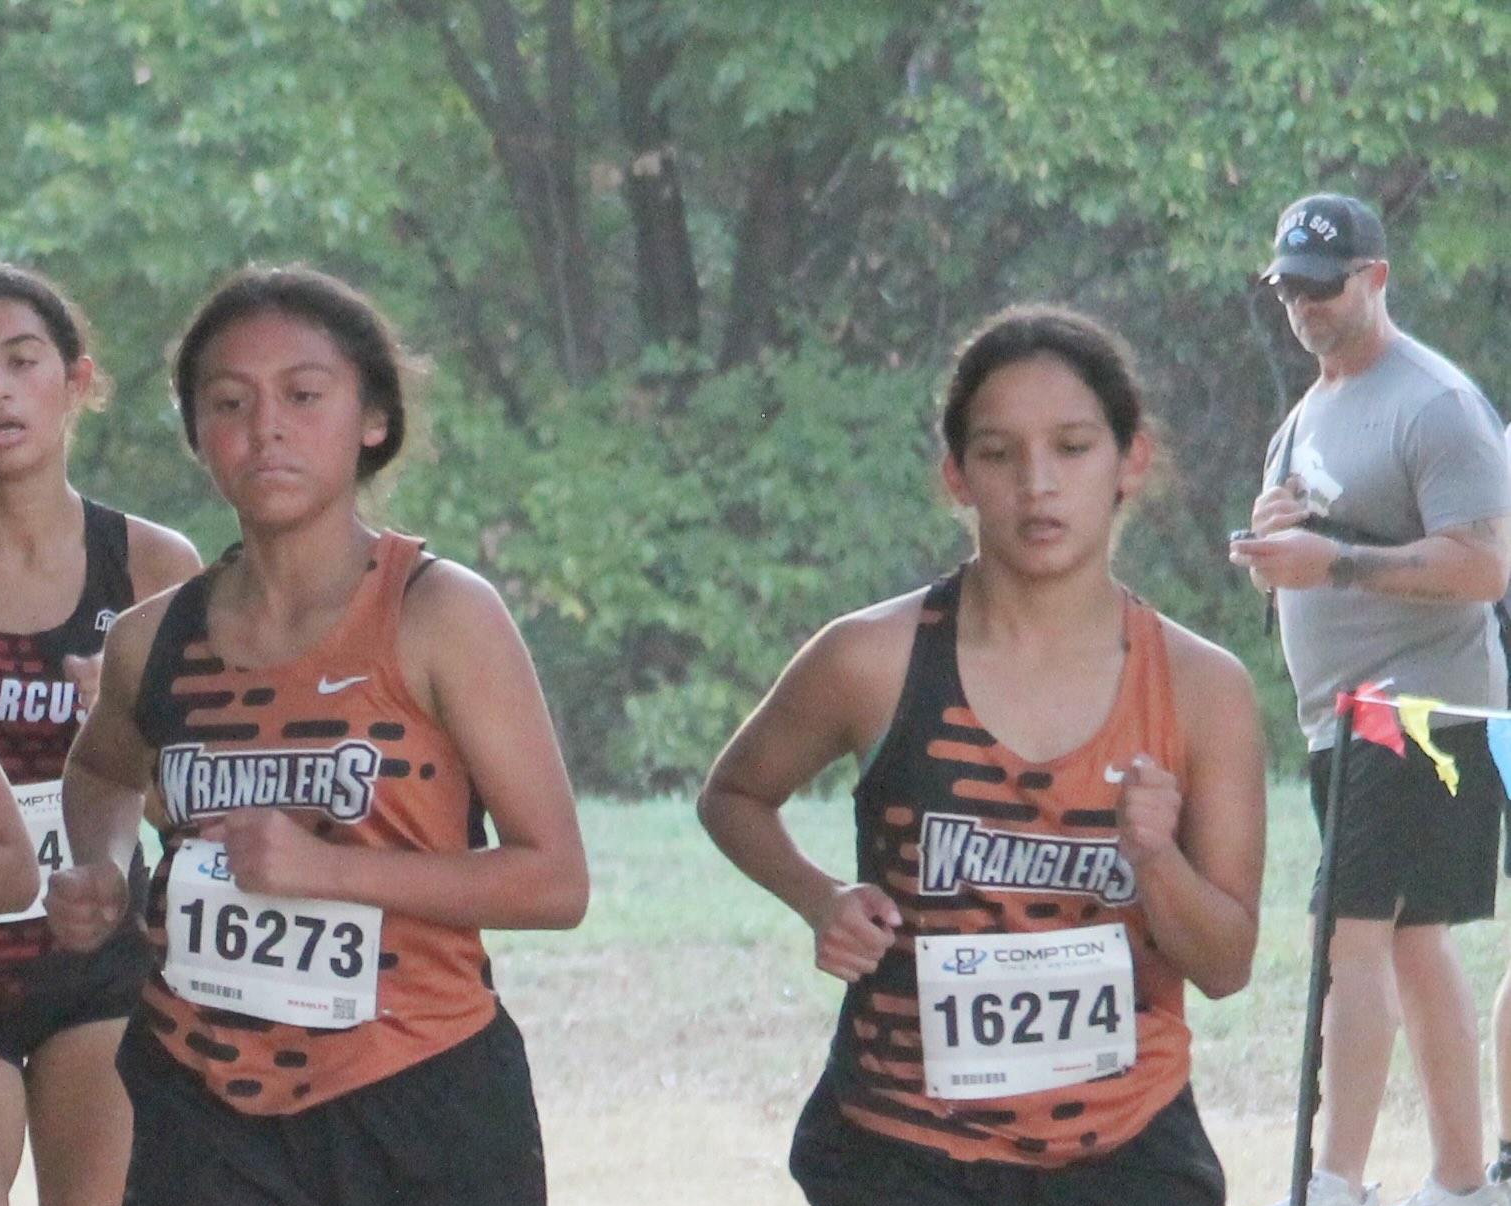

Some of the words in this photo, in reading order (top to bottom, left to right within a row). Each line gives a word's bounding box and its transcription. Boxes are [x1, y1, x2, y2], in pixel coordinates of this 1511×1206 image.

[161, 740, 383, 825] WRANGLERS
[181, 899, 363, 979] 16273
[994, 941, 1105, 963] COMPTON
[934, 985, 1120, 1048] 16274
